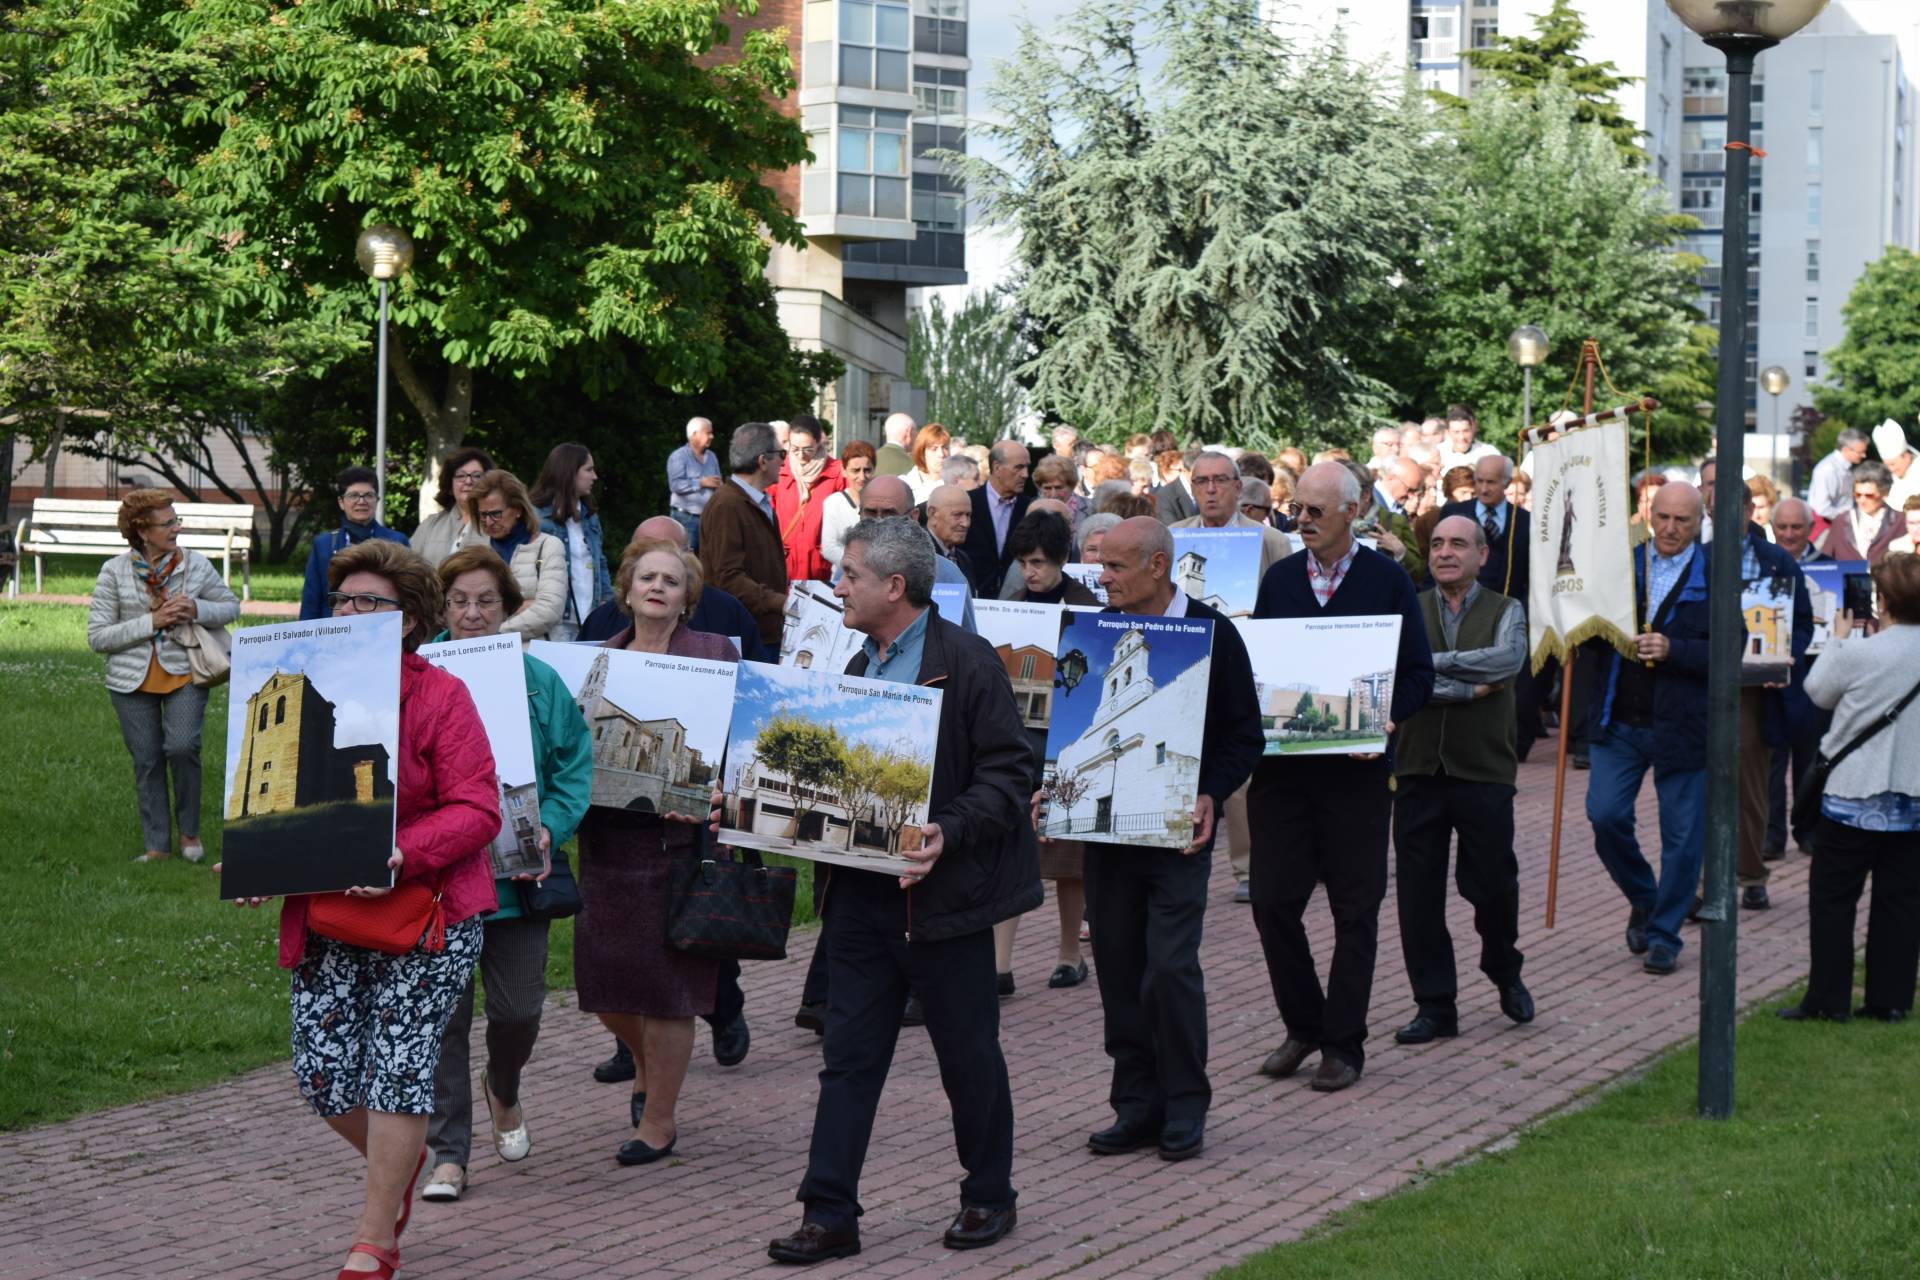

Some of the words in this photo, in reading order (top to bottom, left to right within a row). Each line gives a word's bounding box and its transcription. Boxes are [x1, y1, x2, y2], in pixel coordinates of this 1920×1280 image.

[239, 634, 272, 645] Parroquia
[274, 632, 281, 641] El
[282, 628, 313, 640] Salvador
[315, 624, 352, 638] (Villatoro)
[1098, 619, 1129, 630] Parroquia
[1130, 621, 1143, 630] San
[1145, 622, 1164, 631] Pedro
[1165, 623, 1174, 631] de
[1175, 624, 1181, 632] la
[1183, 624, 1206, 633] Fuente
[1305, 623, 1333, 631] Parroquia
[442, 649, 457, 658] San
[458, 646, 486, 655] Lorenzo
[488, 643, 495, 651] el
[497, 640, 514, 650] Real
[645, 659, 676, 670] Parroquia
[677, 663, 690, 672] San
[691, 665, 716, 675] Lesmes
[717, 668, 734, 677] Abad
[838, 683, 868, 696] Parroquia
[869, 688, 880, 698] San
[903, 693, 911, 702] de
[912, 694, 933, 706] Porres
